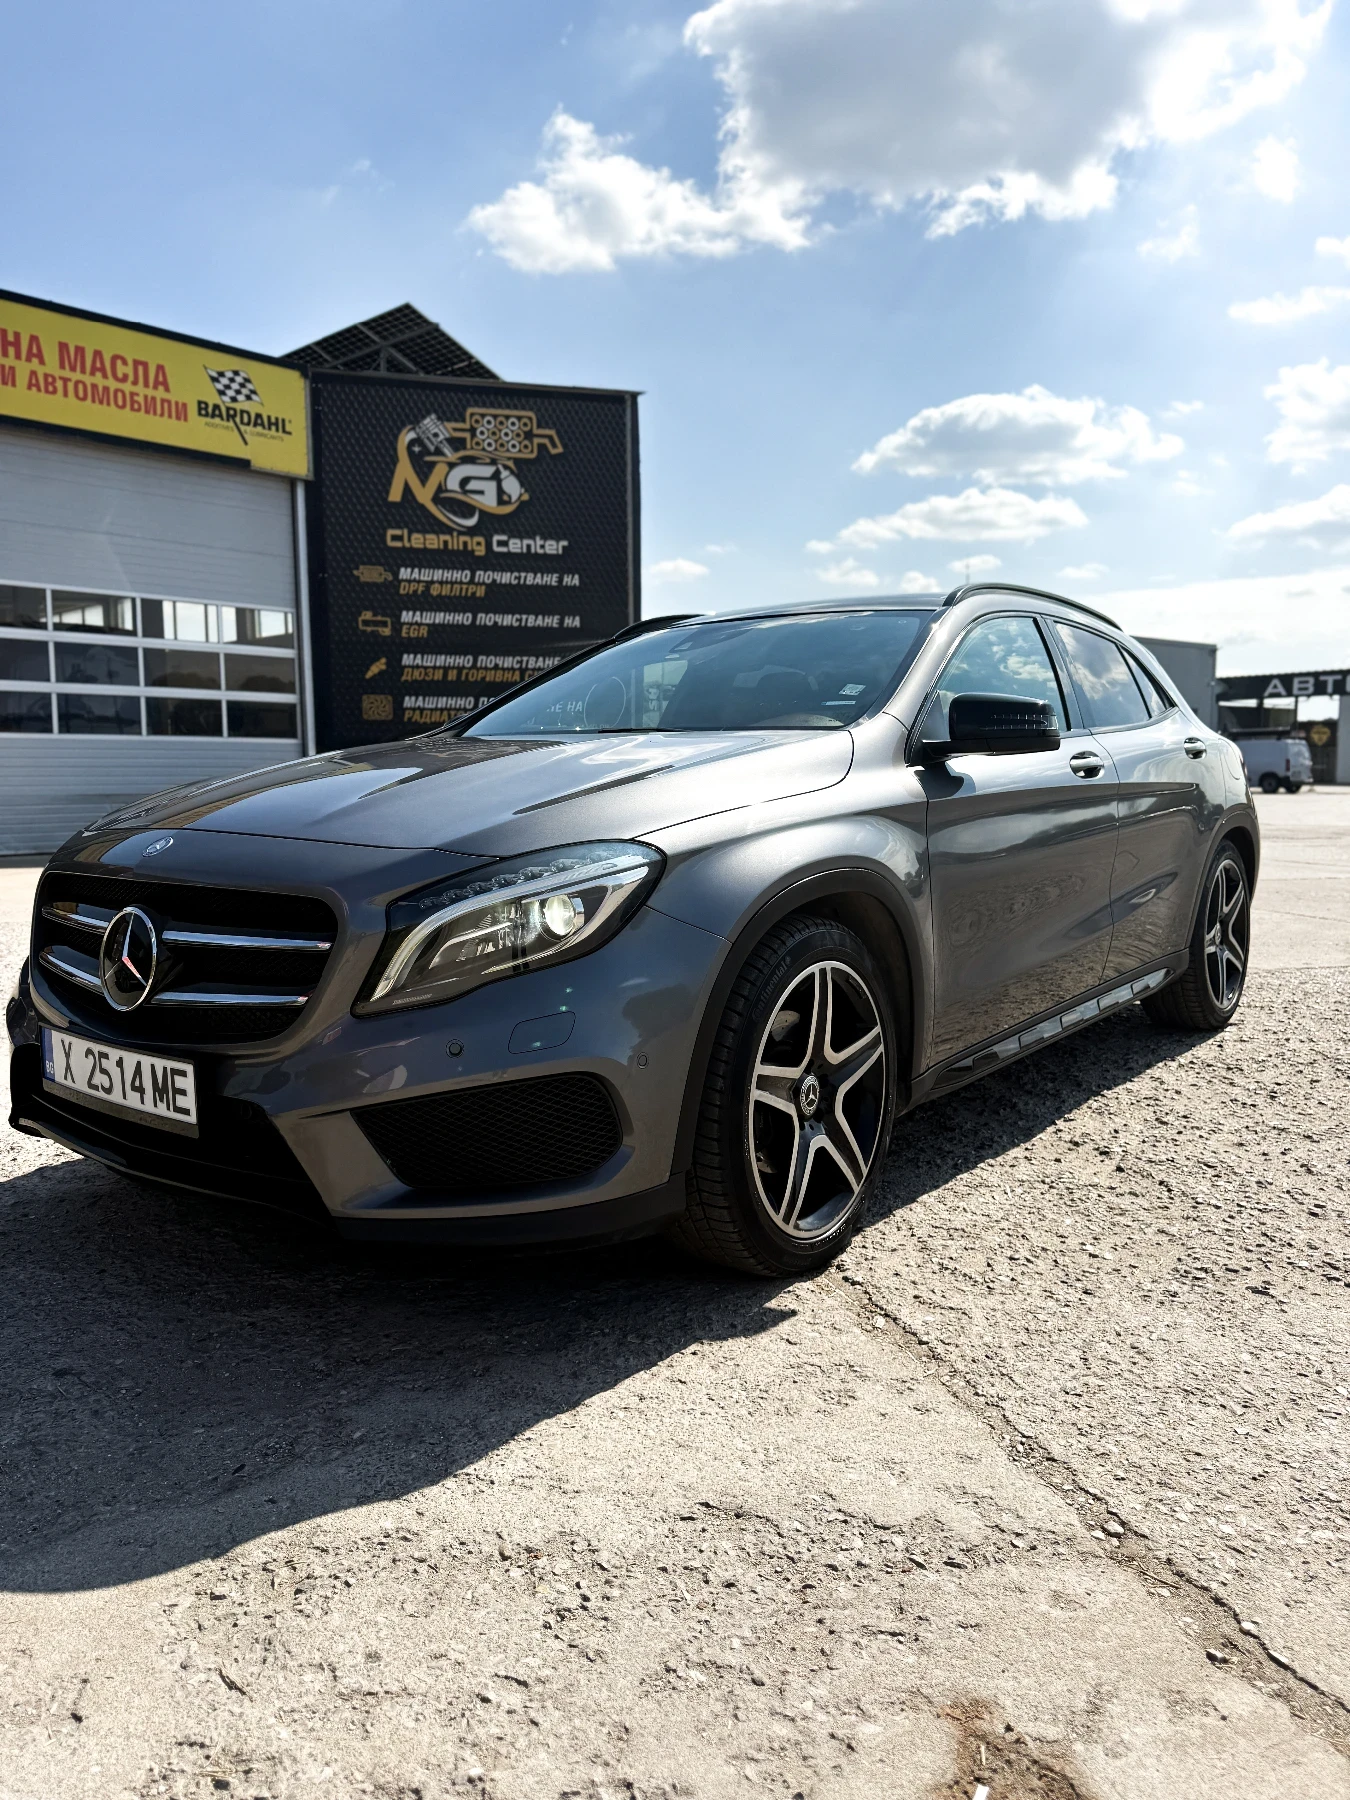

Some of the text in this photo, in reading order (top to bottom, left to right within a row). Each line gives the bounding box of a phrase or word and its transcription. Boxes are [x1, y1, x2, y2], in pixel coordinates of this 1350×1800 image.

[0, 327, 171, 393] НА МАСЛА
[26, 369, 188, 423] АВТОМОБИЛИ
[197, 399, 292, 436] BARDAHL
[386, 529, 569, 556] Cleaning Center
[399, 567, 580, 587] МАШИННО ПОЧИСТВАНЕ НА
[399, 581, 486, 598] DPF ФИЛТРИ
[401, 610, 581, 629] МАШИННО ПОЧИСТВАНЕ НА
[401, 625, 428, 639] EGR
[401, 653, 473, 667] МАШИННО
[401, 667, 444, 682] ДЮЗИ
[447, 669, 457, 681] И
[461, 668, 521, 683] ГОРИВНА
[403, 696, 475, 710] МАШИННО
[404, 709, 470, 724] РАДИАТ
[61, 1038, 76, 1085] X
